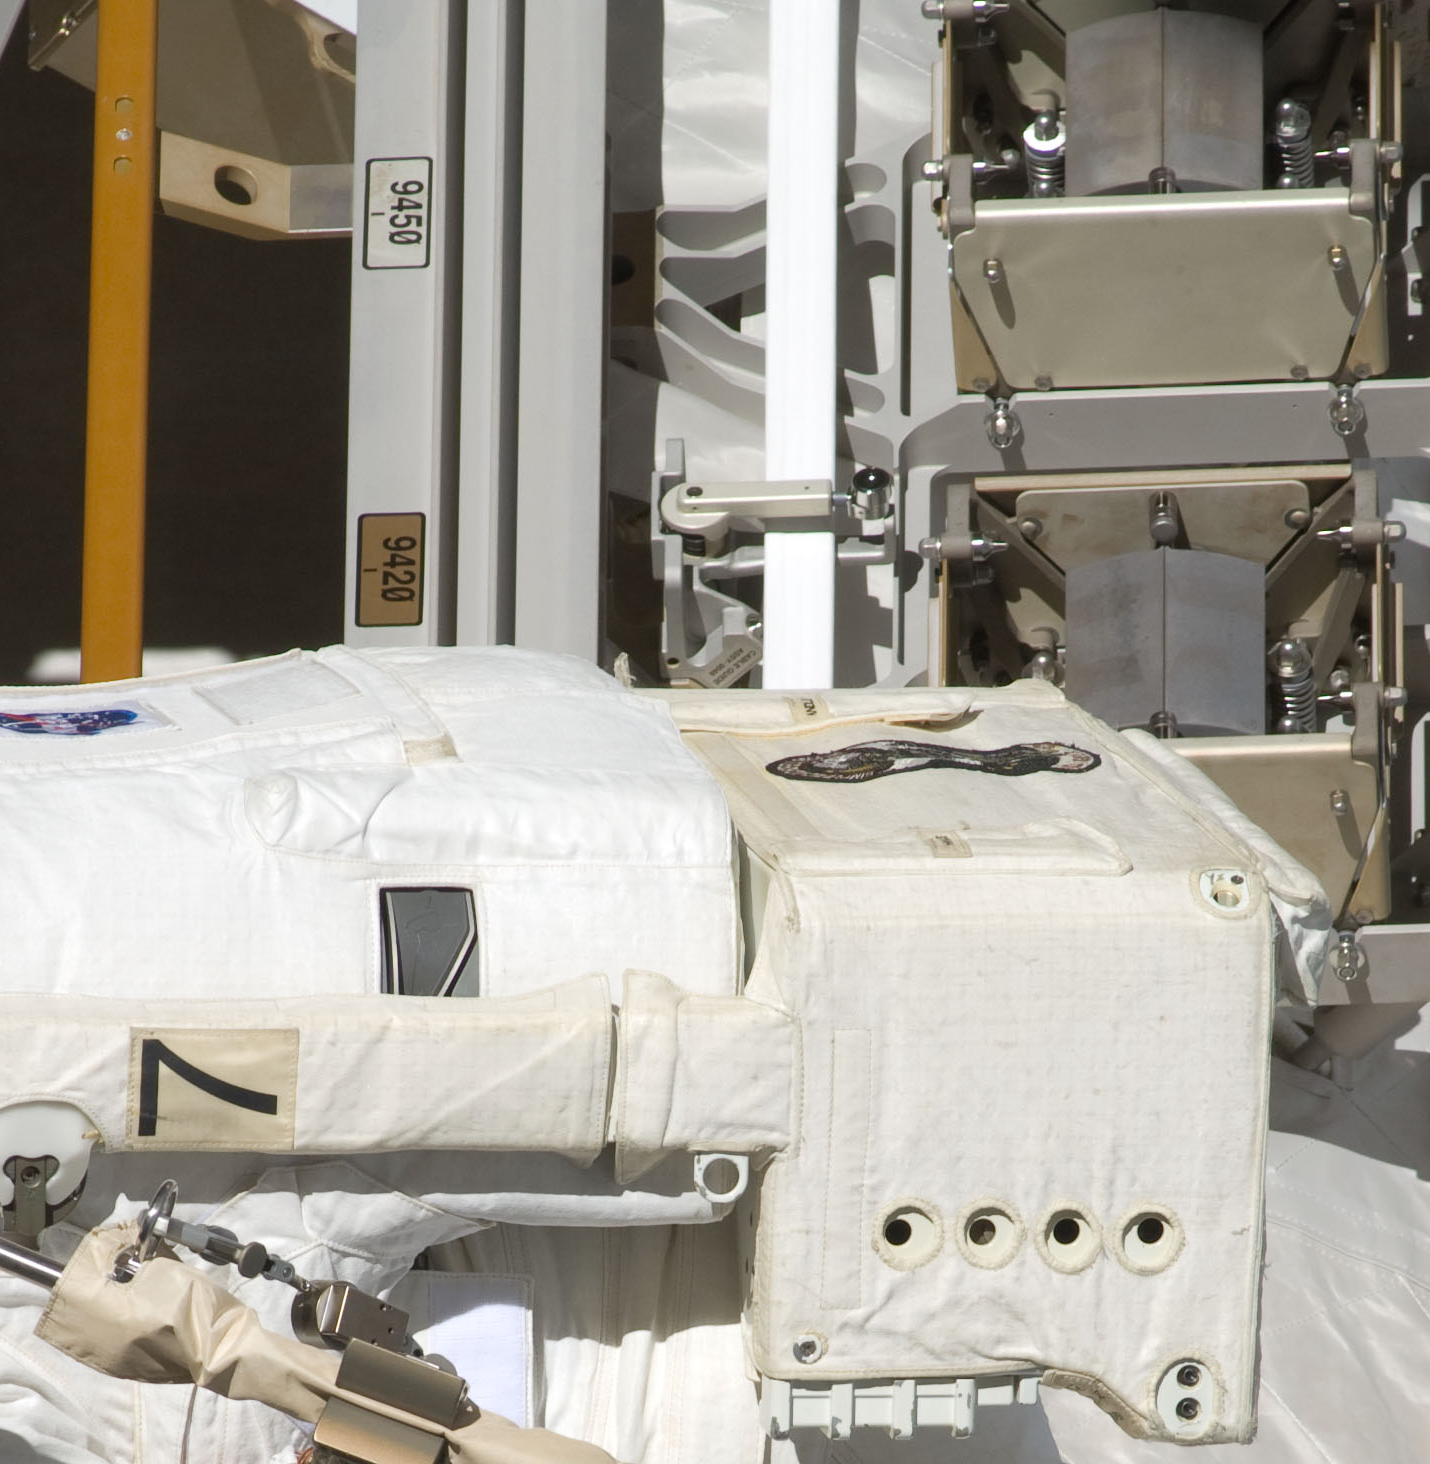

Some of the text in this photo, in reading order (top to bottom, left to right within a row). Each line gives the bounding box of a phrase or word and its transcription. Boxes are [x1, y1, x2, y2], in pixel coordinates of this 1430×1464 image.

[388, 180, 424, 245] 9450
[381, 536, 417, 602] 9420
[138, 1038, 278, 1137] 7
